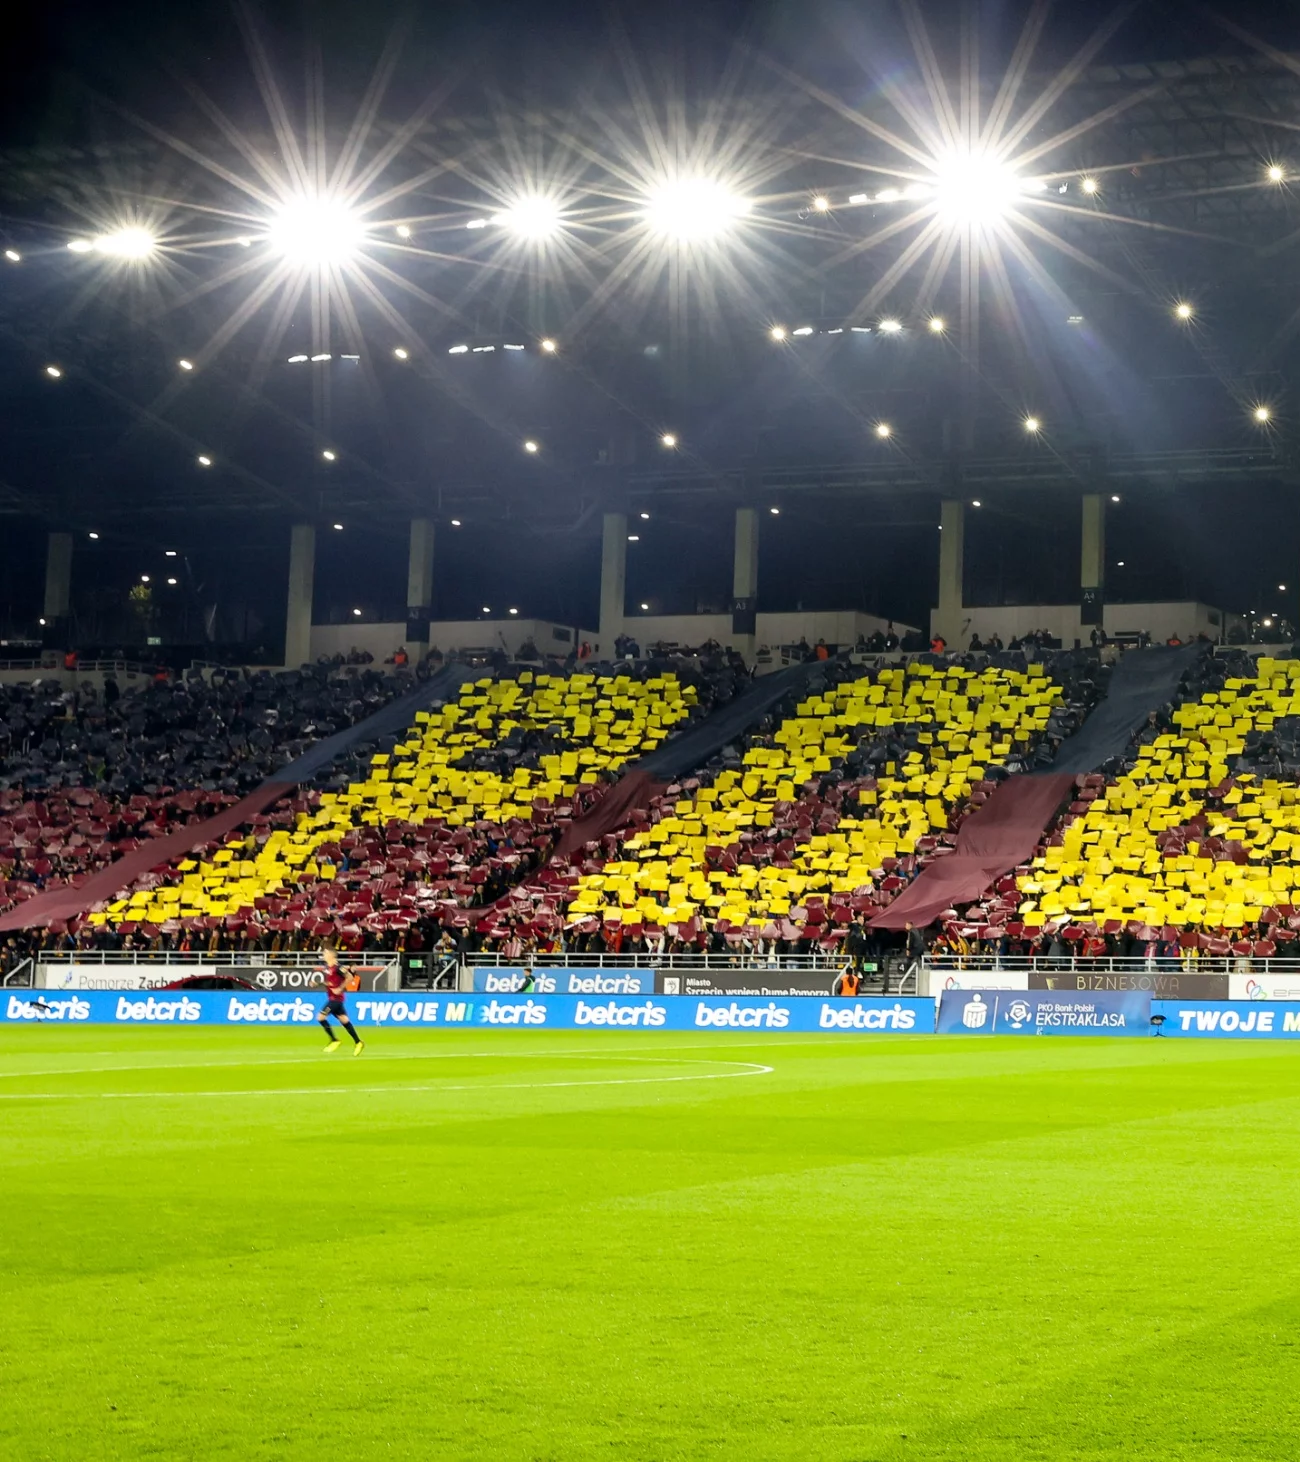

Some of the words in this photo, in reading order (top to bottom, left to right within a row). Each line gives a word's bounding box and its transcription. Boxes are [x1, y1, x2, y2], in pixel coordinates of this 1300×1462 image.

[79, 976, 134, 990] Pomorze
[280, 971, 325, 987] TOYO
[568, 974, 641, 994] betcris
[686, 978, 711, 987] Miasto
[1076, 976, 1180, 990] BIZNESOWA
[7, 995, 91, 1020] betcris
[115, 996, 202, 1021] betcris
[227, 997, 314, 1022] betcris
[355, 1001, 439, 1022] TWOJE
[574, 1000, 667, 1026] betcris
[694, 1001, 790, 1028] betcris
[819, 1003, 915, 1029] betcris
[1037, 1003, 1054, 1012] PKO
[1054, 1003, 1073, 1012] Bank
[1074, 1004, 1095, 1012] Polski
[1035, 1012, 1126, 1027] EKSTRAKLASA
[1179, 1010, 1275, 1032] TWOJE
